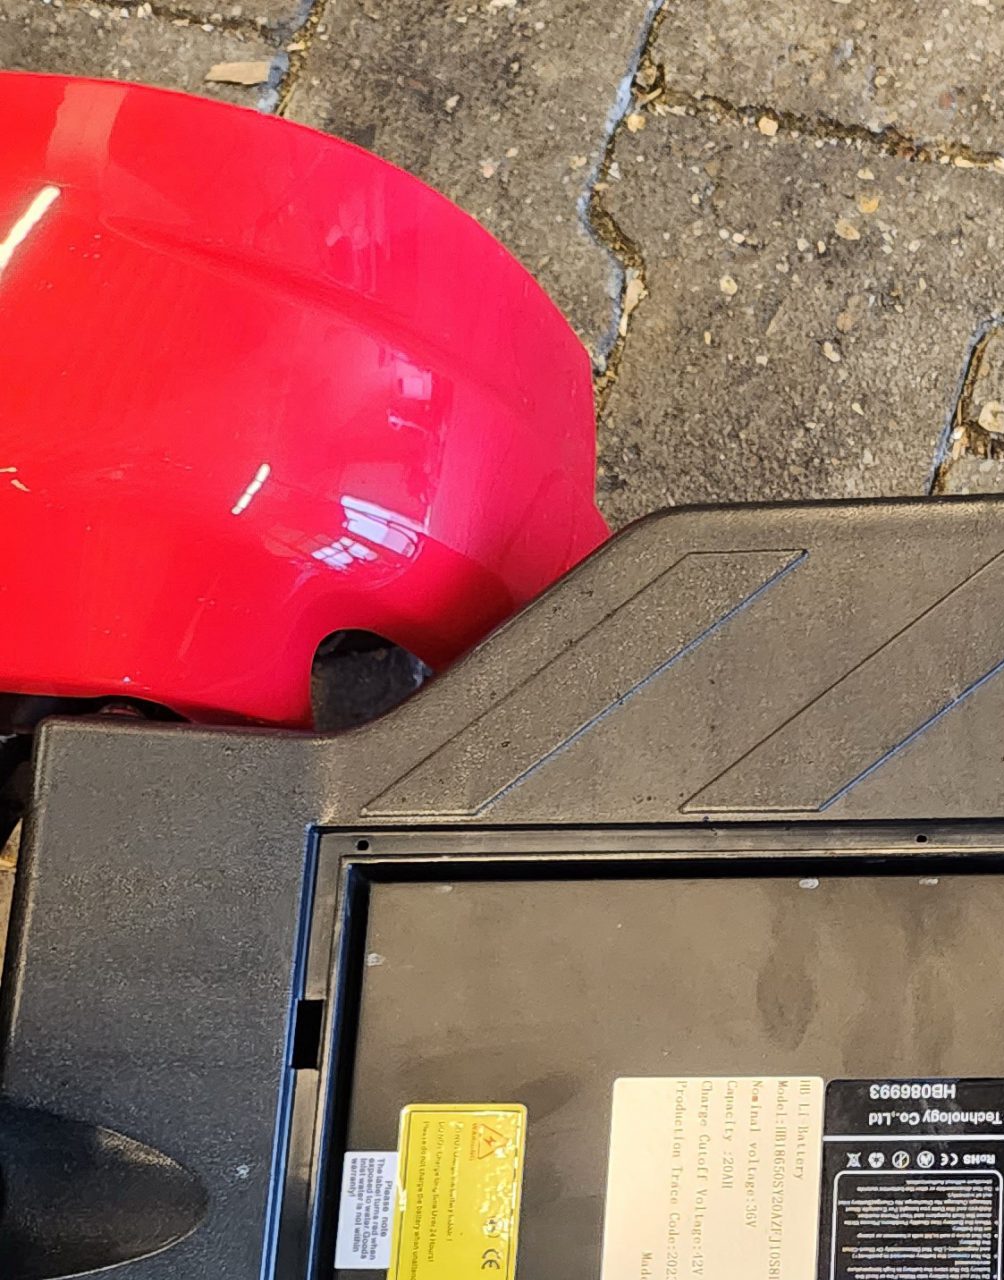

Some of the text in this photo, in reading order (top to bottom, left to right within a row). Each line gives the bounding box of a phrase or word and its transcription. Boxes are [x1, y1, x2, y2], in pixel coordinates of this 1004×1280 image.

[698, 1081, 712, 1126] Charge
[870, 1084, 956, 1099] HB086993
[672, 1081, 688, 1157] Production
[723, 1080, 738, 1141] Capacity
[869, 1110, 920, 1125] Co.,Ltd
[923, 1110, 1002, 1125] Technology
[793, 1080, 810, 1180] HB Li Battery
[697, 1135, 710, 1180] Cutoff
[745, 1080, 763, 1228] Nominal voltage:36V
[963, 1153, 995, 1164] RoHS
[347, 1158, 358, 1197] warranty!
[366, 1158, 376, 1194] exposed
[376, 1159, 385, 1174] The
[357, 1178, 365, 1201] water
[376, 1176, 384, 1196] label
[417, 1168, 426, 1192] charge
[670, 1167, 684, 1204] Trace
[366, 1195, 373, 1204] to
[380, 1180, 392, 1237] Please note
[354, 1212, 362, 1225] not
[414, 1206, 422, 1230] battery
[353, 1227, 361, 1252] within
[430, 1228, 436, 1237] 24
[370, 1237, 378, 1260] when
